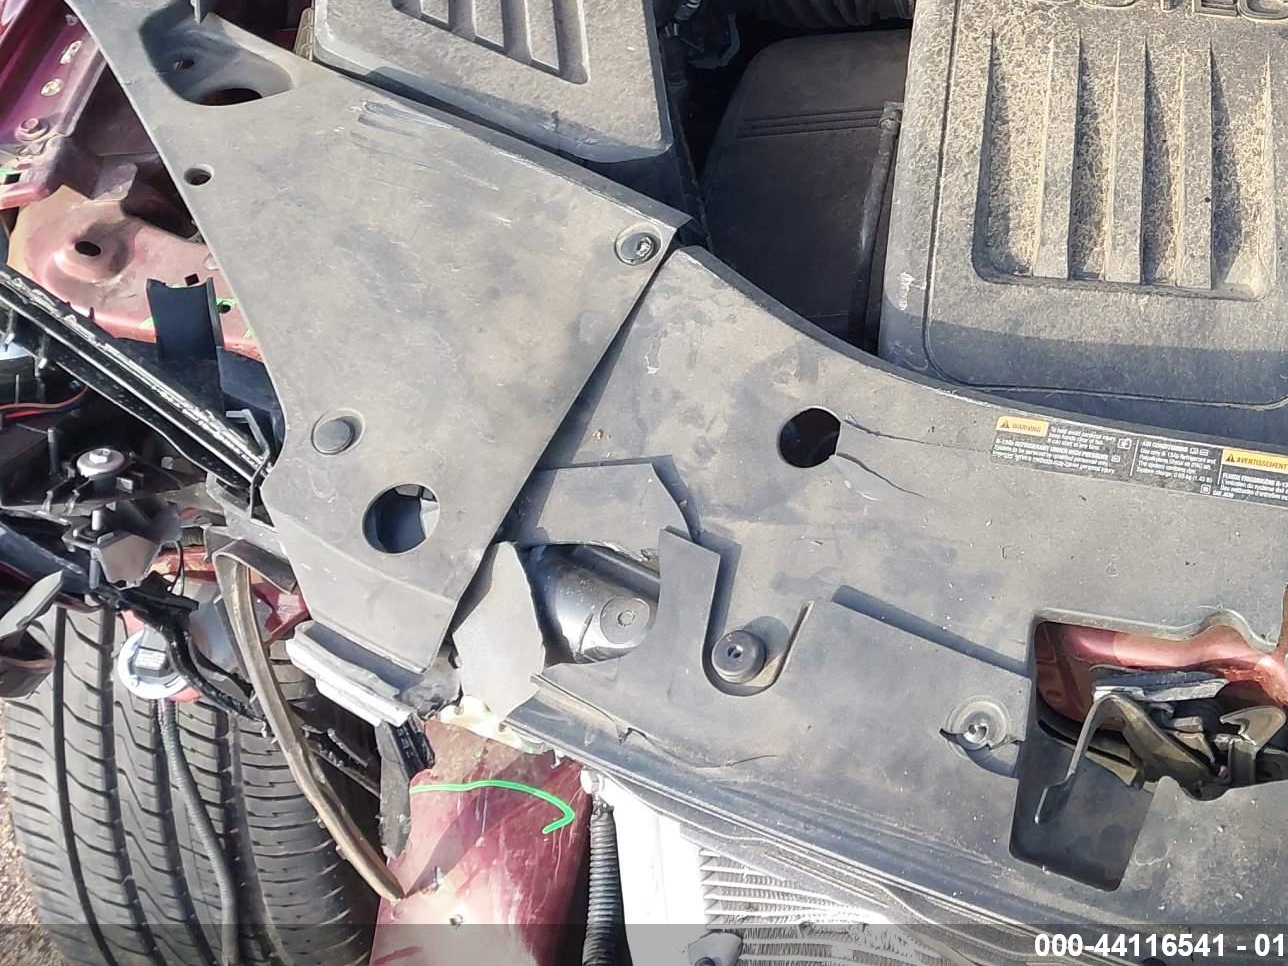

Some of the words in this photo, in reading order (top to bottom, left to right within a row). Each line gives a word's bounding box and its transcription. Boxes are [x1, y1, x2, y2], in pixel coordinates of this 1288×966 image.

[1013, 423, 1042, 433] WARNING
[1152, 442, 1188, 452] CONDITIONING
[1237, 457, 1288, 470] AVERTISSEMENT
